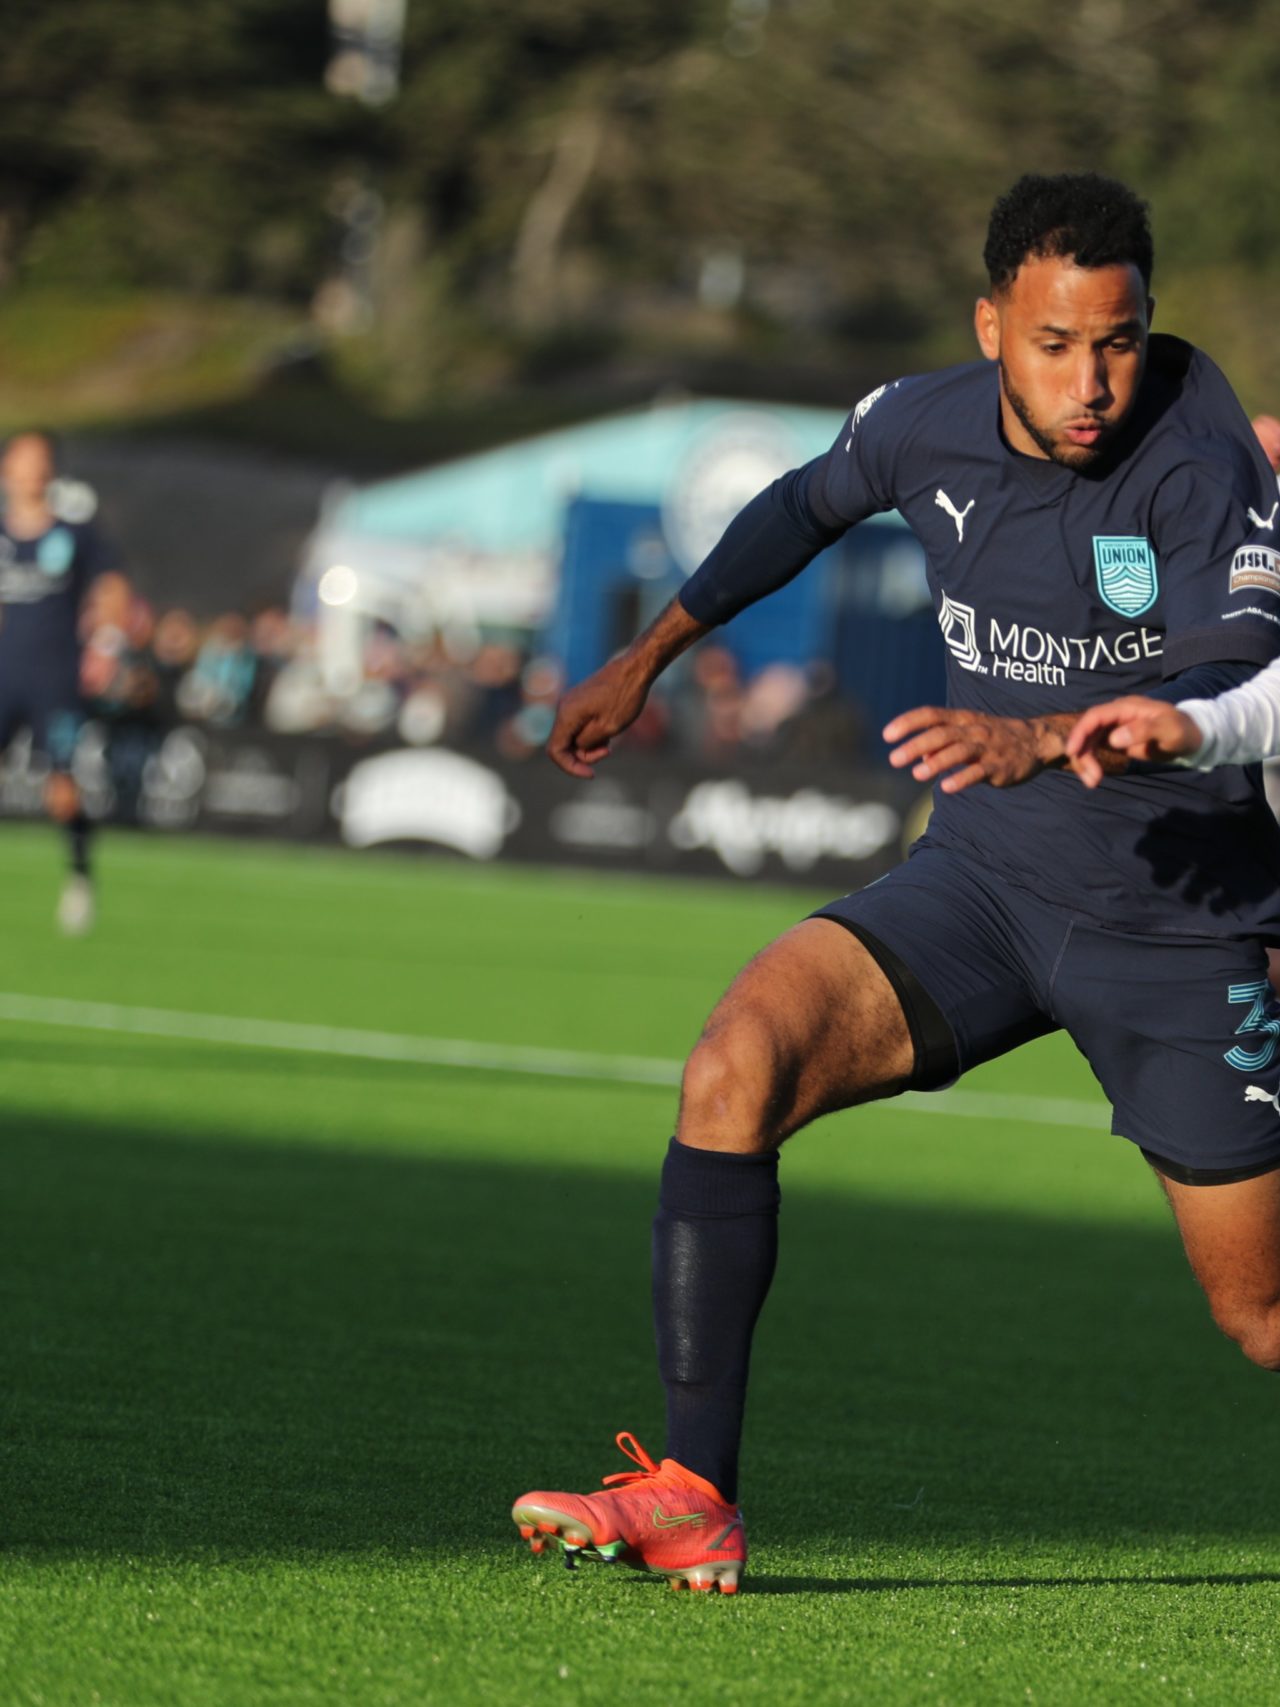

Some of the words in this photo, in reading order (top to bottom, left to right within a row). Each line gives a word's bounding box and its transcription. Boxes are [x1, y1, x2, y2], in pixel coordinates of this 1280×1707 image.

[1102, 547, 1147, 565] UNION
[990, 618, 1163, 670] MONTAGE
[993, 654, 1066, 687] Health
